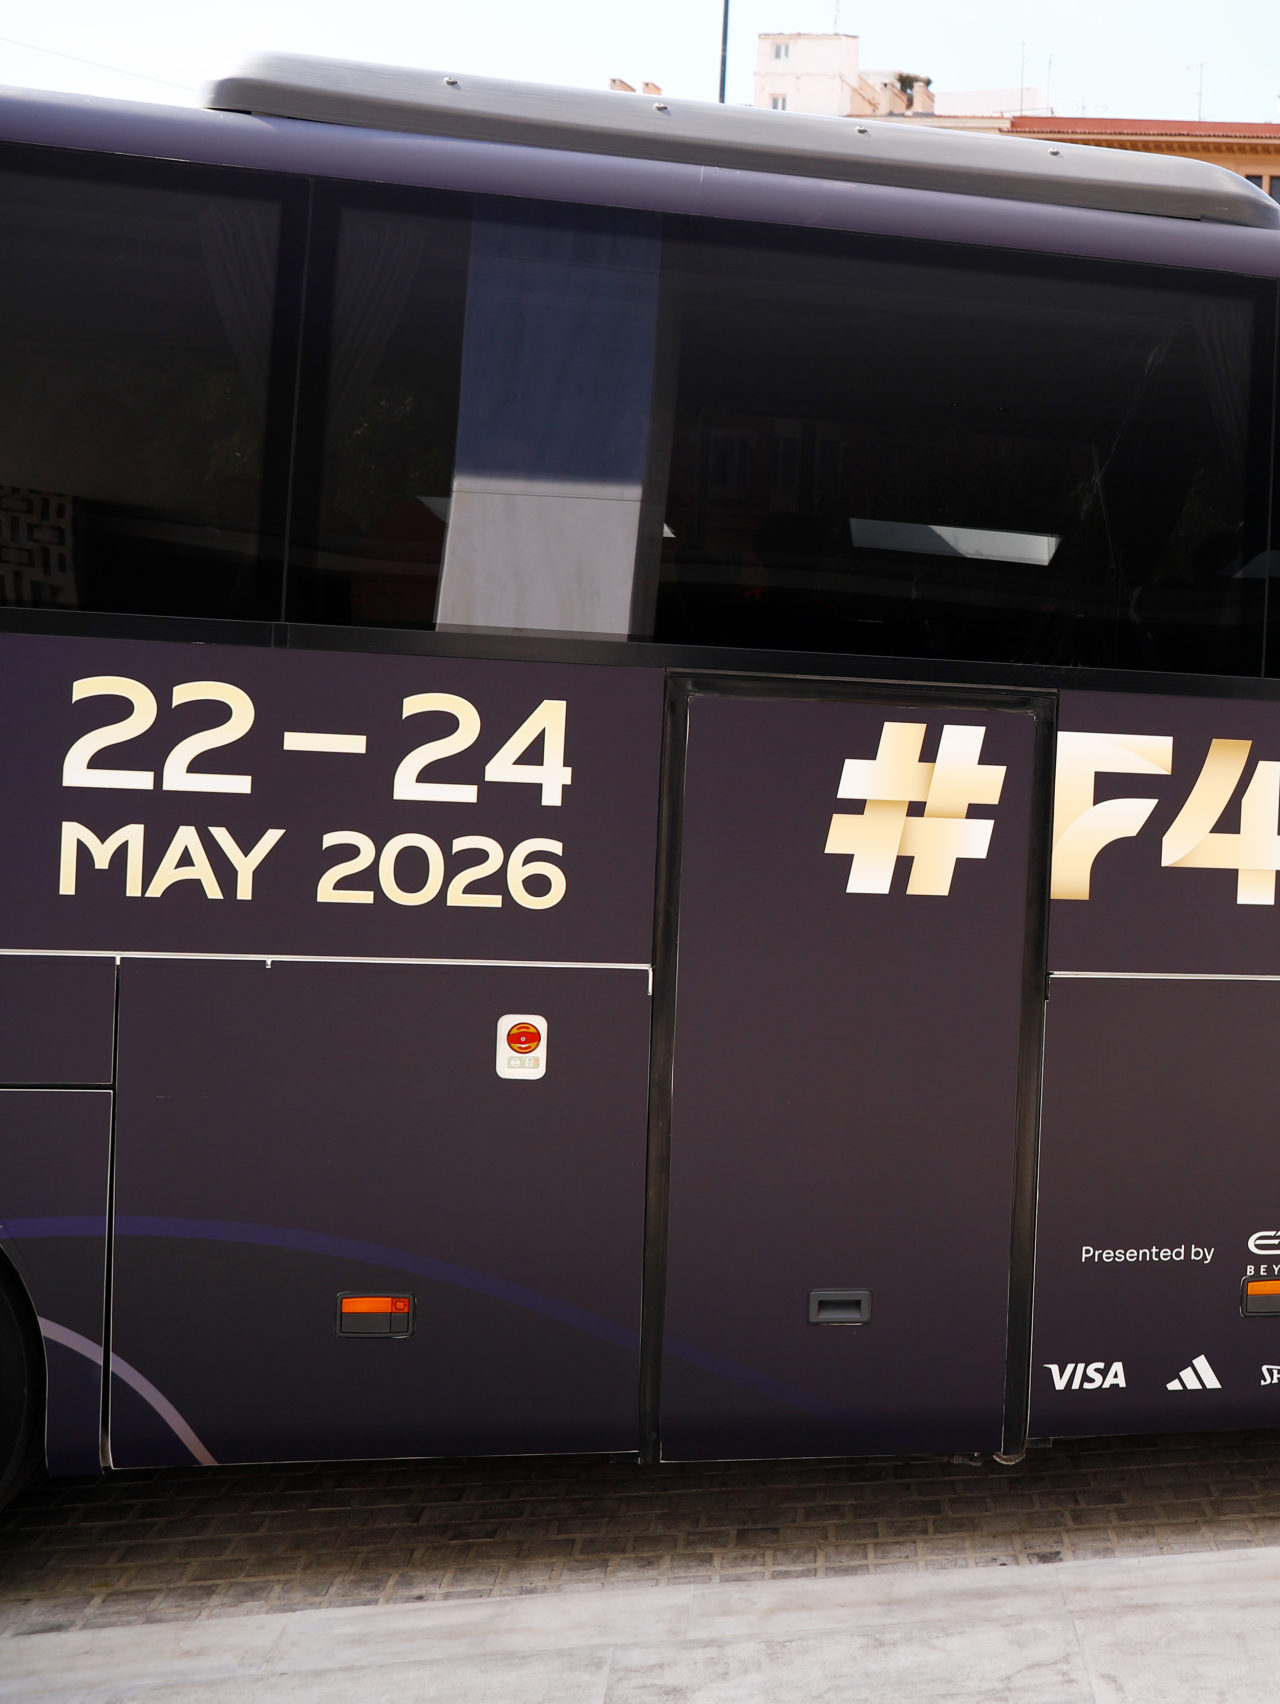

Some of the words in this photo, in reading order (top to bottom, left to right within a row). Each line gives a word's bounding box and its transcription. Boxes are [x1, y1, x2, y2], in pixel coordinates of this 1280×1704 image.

[63, 676, 255, 794] 22
[393, 693, 572, 806] 24
[59, 821, 286, 900] MAY
[317, 831, 567, 909] 2026
[1081, 1244, 1184, 1263] Presented
[1190, 1244, 1215, 1264] by
[1043, 1362, 1127, 1390] VISA
